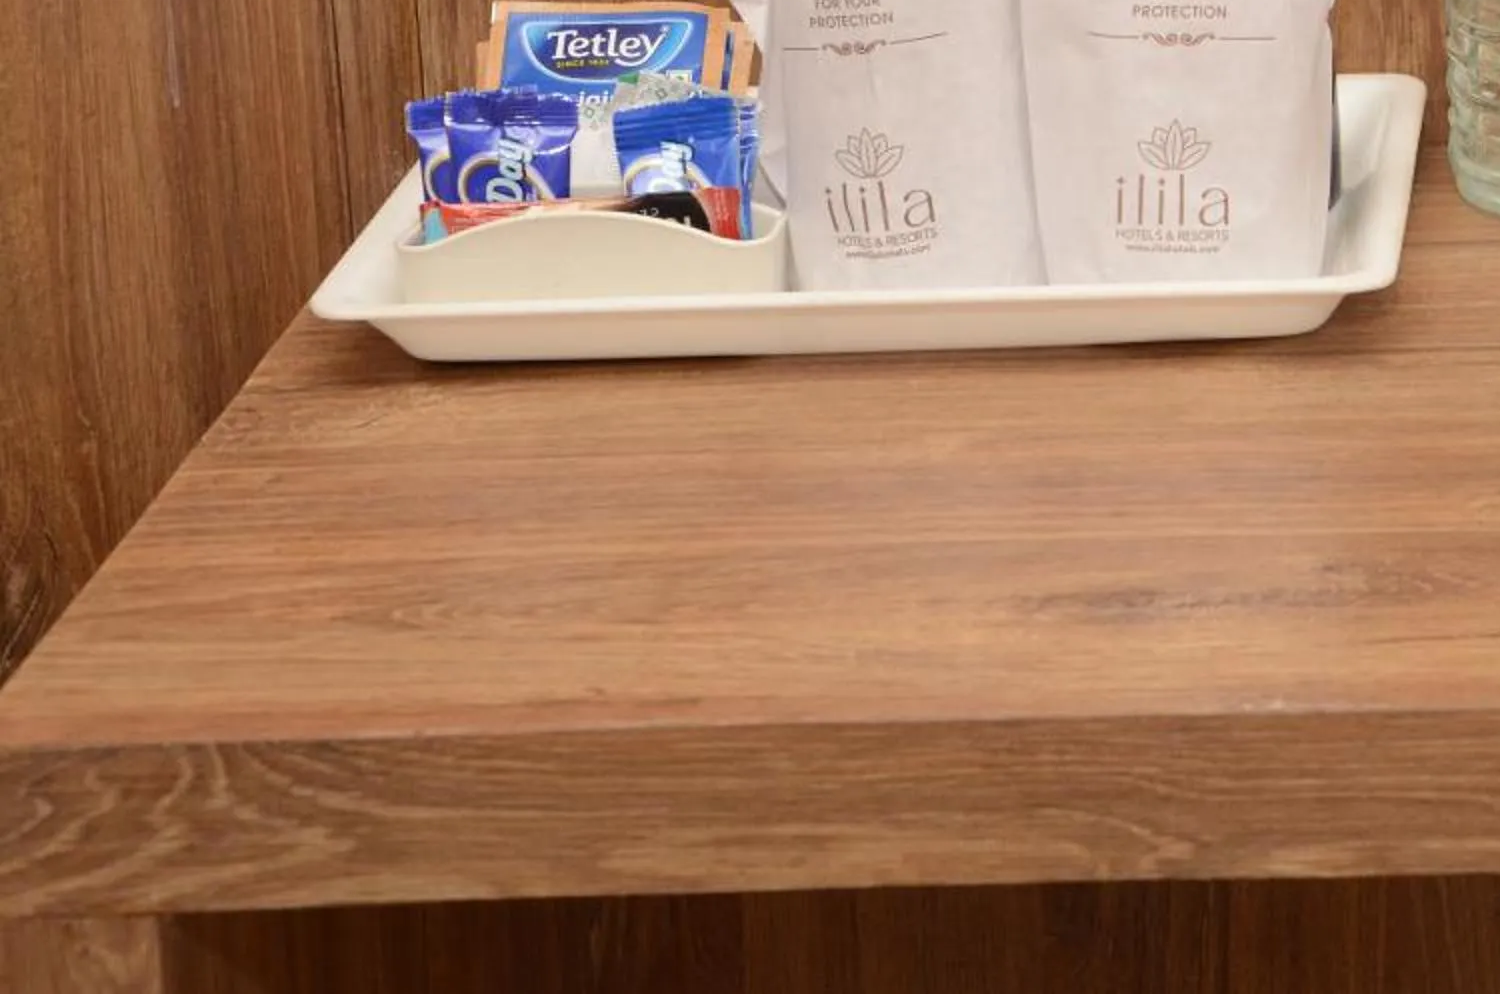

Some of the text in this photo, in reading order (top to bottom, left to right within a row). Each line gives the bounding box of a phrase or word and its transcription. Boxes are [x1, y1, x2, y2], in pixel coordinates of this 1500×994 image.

[809, 11, 894, 29] PROTECTION
[1132, 5, 1227, 20] PROTECTION
[547, 27, 669, 67] Tetley
[825, 180, 937, 233] ilila
[1116, 174, 1229, 227] ilila
